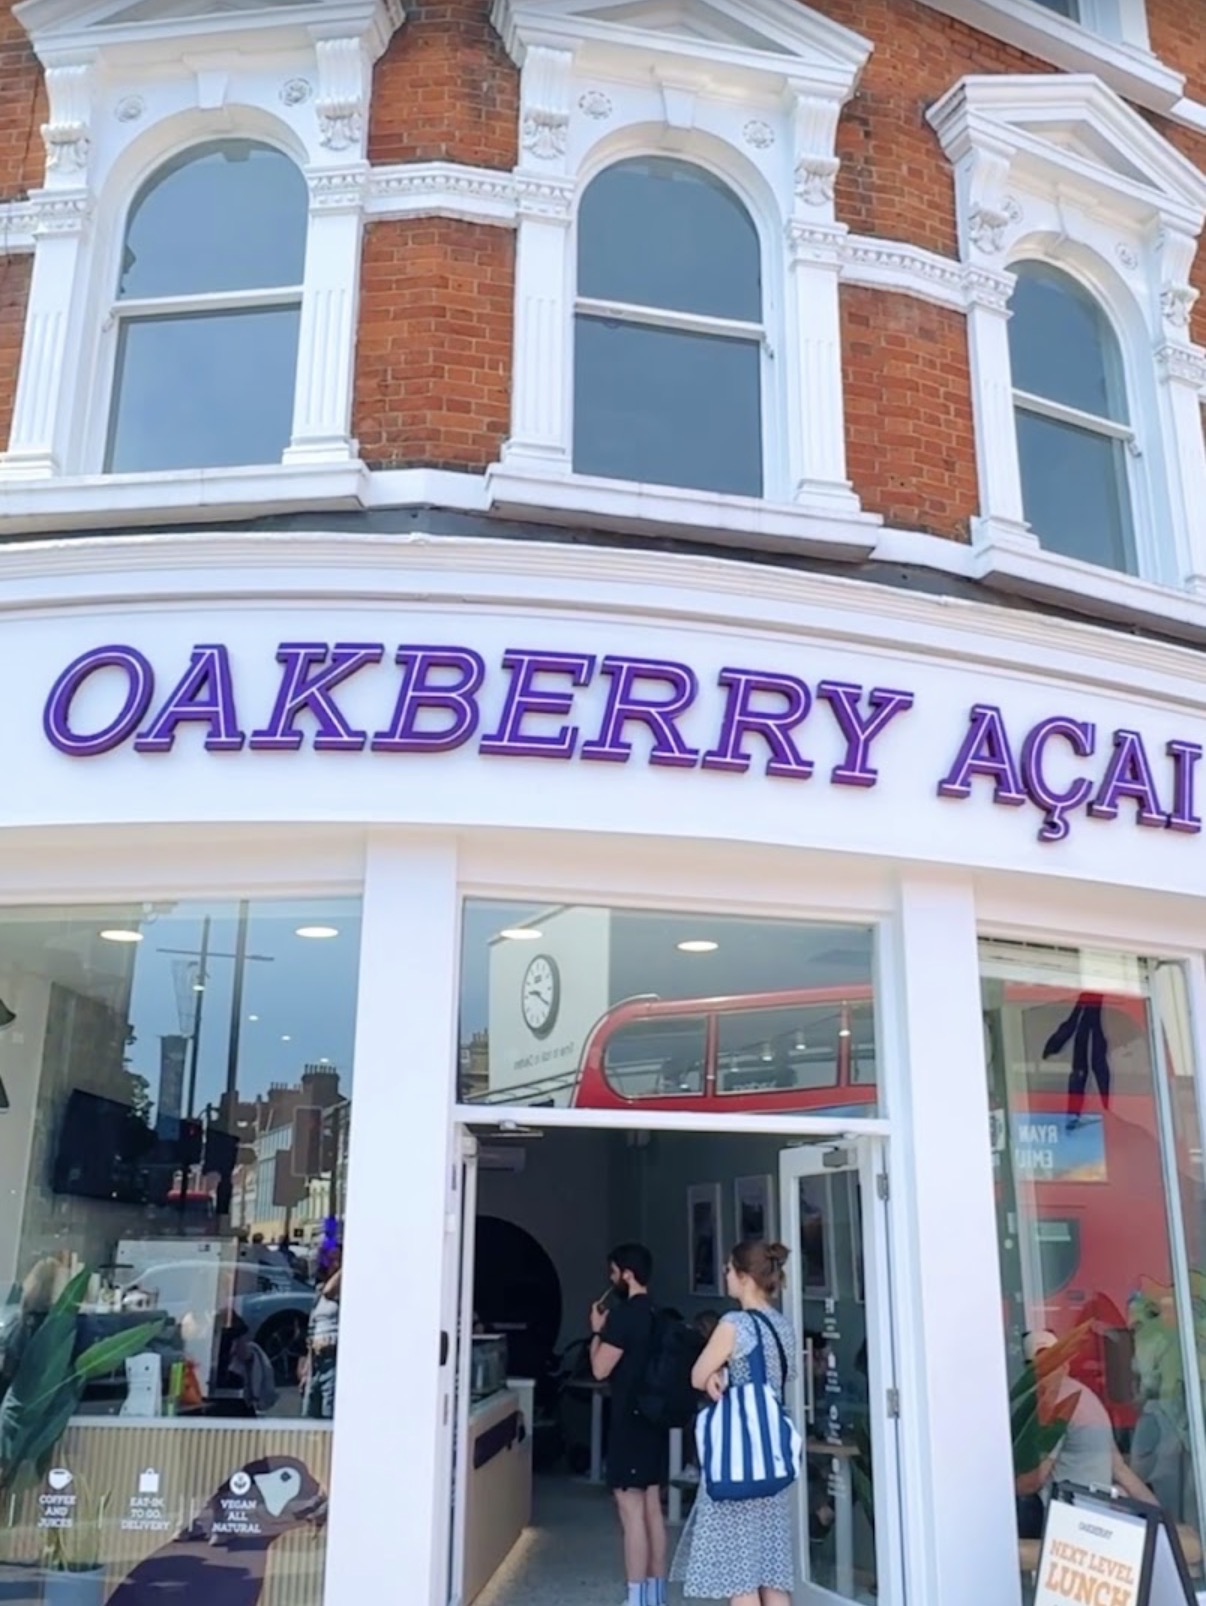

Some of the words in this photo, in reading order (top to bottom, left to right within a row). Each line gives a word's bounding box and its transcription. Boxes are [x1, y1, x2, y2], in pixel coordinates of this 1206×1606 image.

[43, 642, 913, 787] OAKBERRY
[937, 704, 1202, 842] AÇAI
[39, 1495, 76, 1505] COFFEE
[220, 1499, 257, 1509] VEGAN
[44, 1506, 68, 1517] AND
[130, 1508, 145, 1519] TO
[227, 1511, 248, 1522] ALL
[37, 1517, 73, 1528] JUICES
[120, 1519, 171, 1531] DELIVERY
[211, 1522, 262, 1534] NATURAL
[1050, 1540, 1087, 1566] NEXT
[1088, 1554, 1133, 1584] LEVEL
[1045, 1563, 1131, 1606] LUNCH
